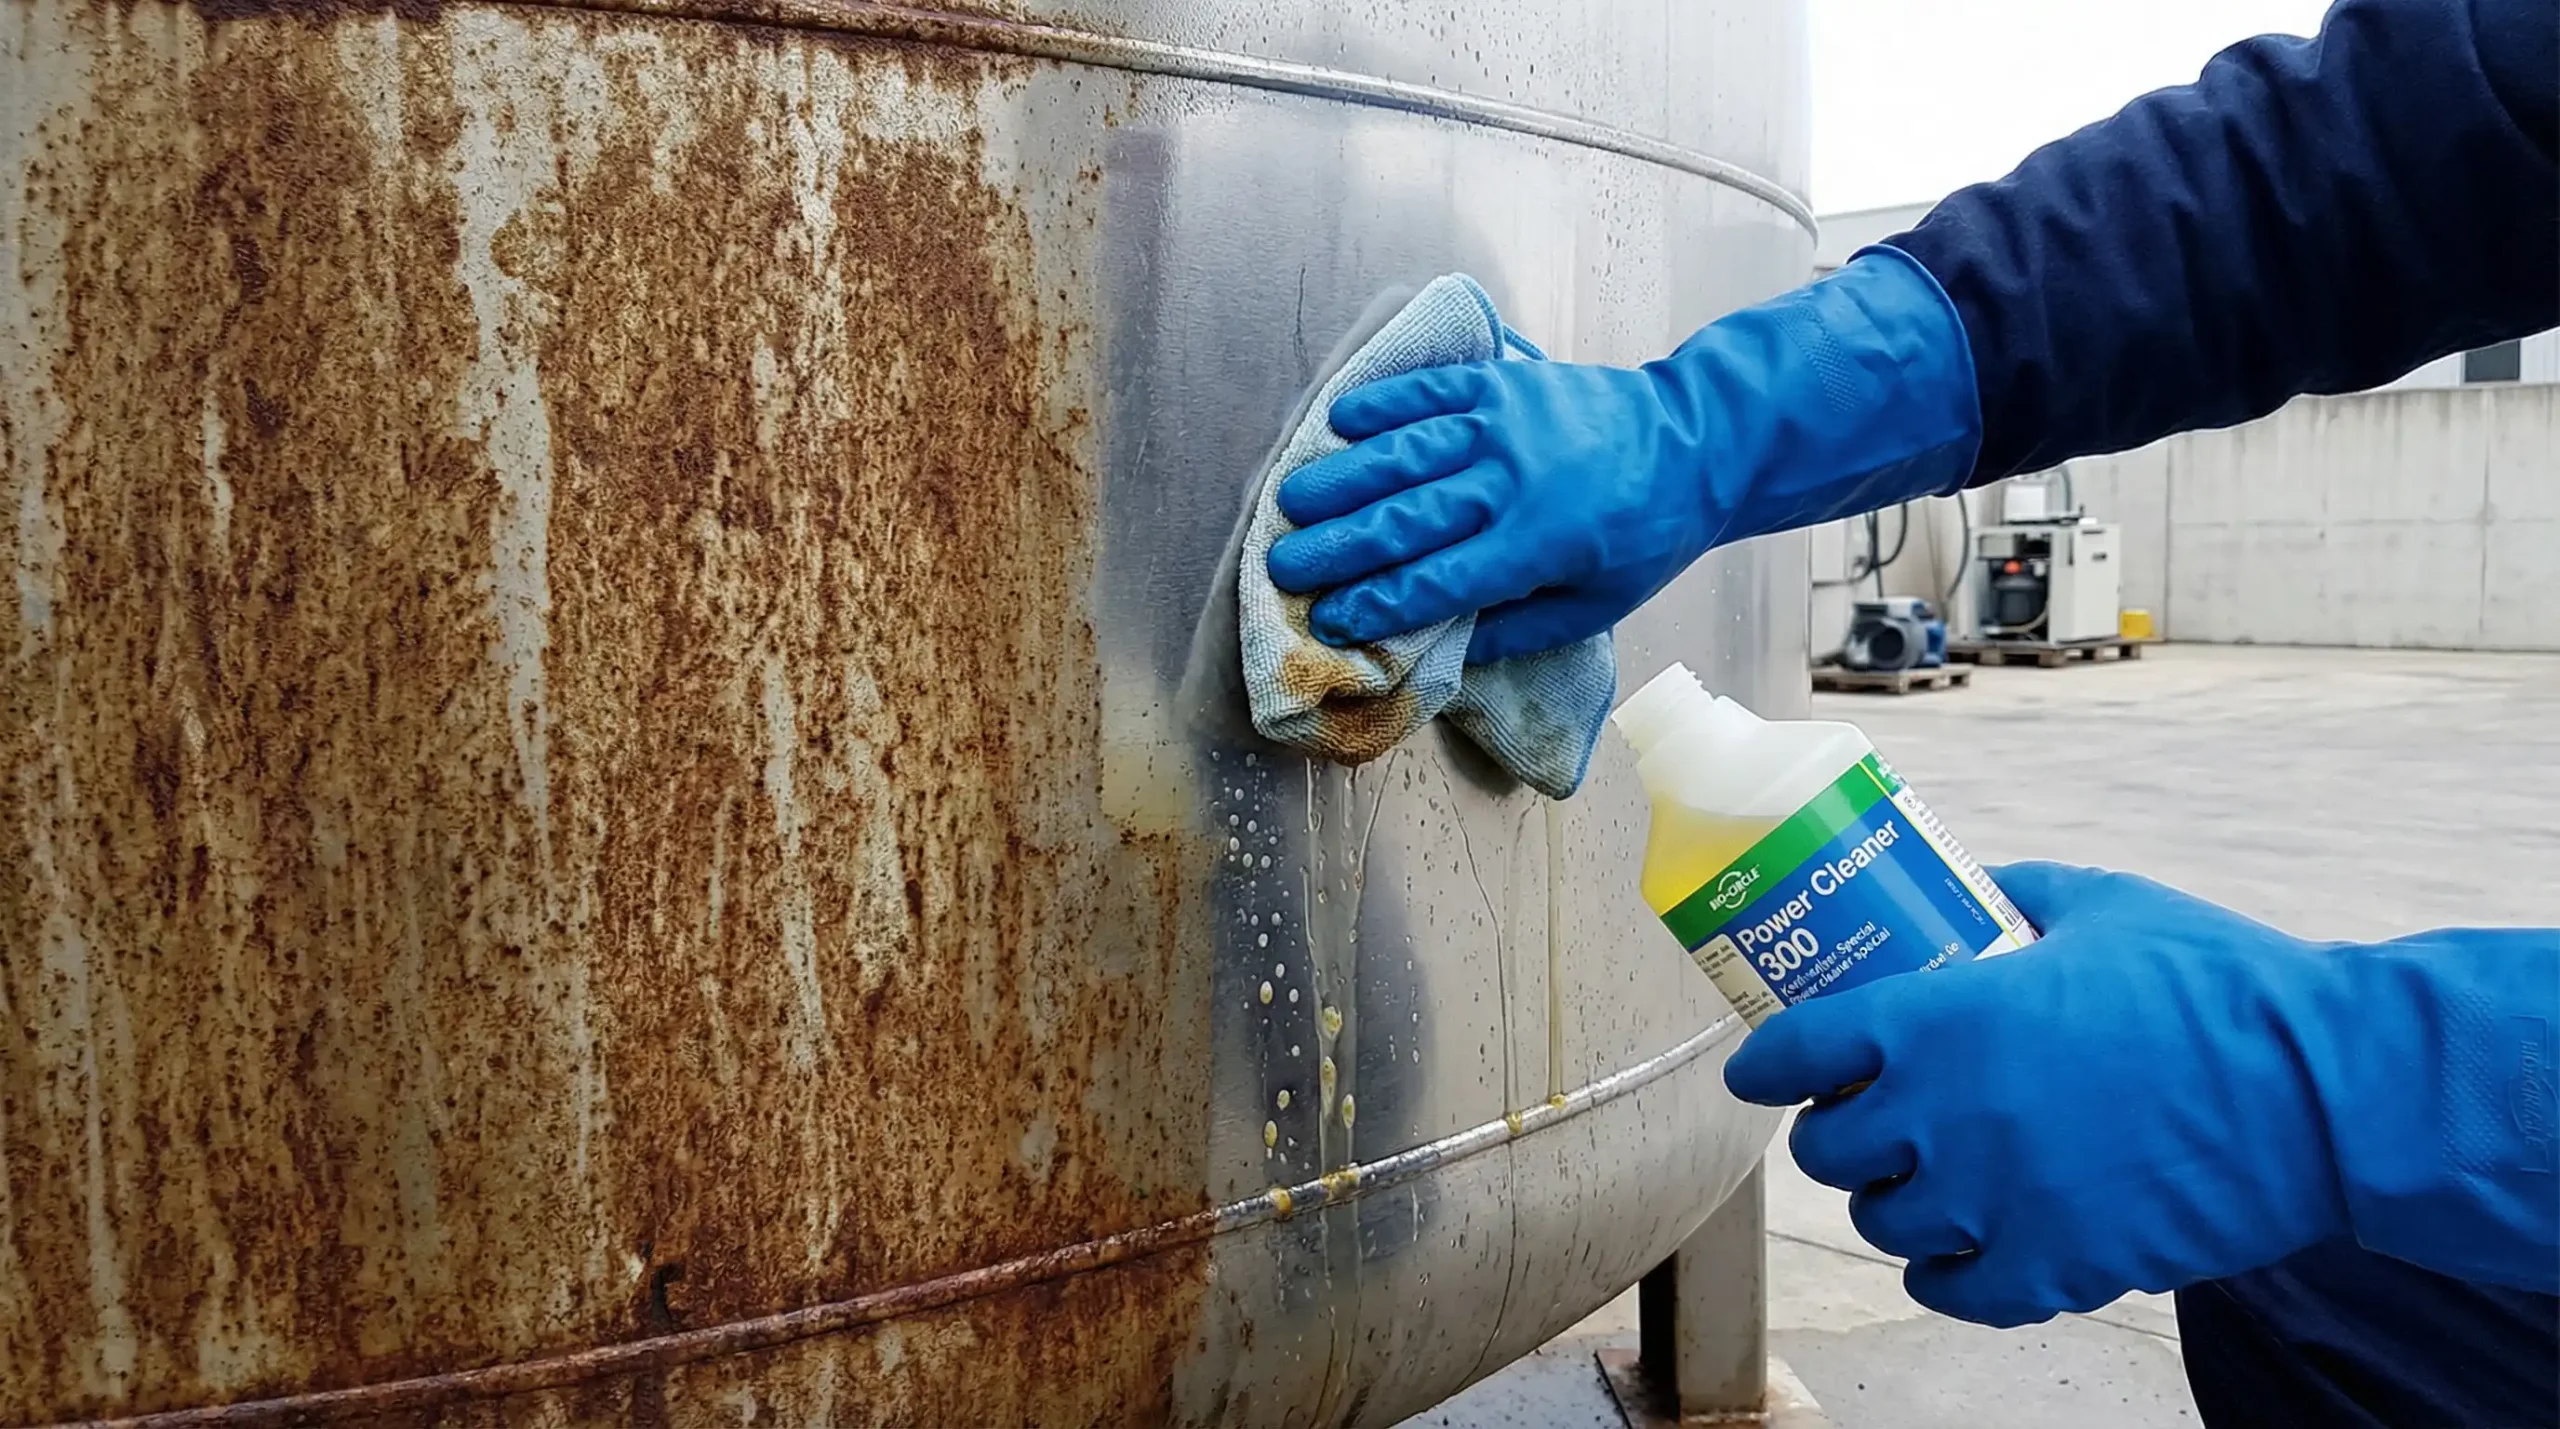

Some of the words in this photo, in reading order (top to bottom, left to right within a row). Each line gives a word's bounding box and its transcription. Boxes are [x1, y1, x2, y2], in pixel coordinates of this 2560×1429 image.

[1736, 889, 1813, 954] Power
[1810, 819, 1900, 896] Cleaner
[1758, 927, 1819, 981] 300
